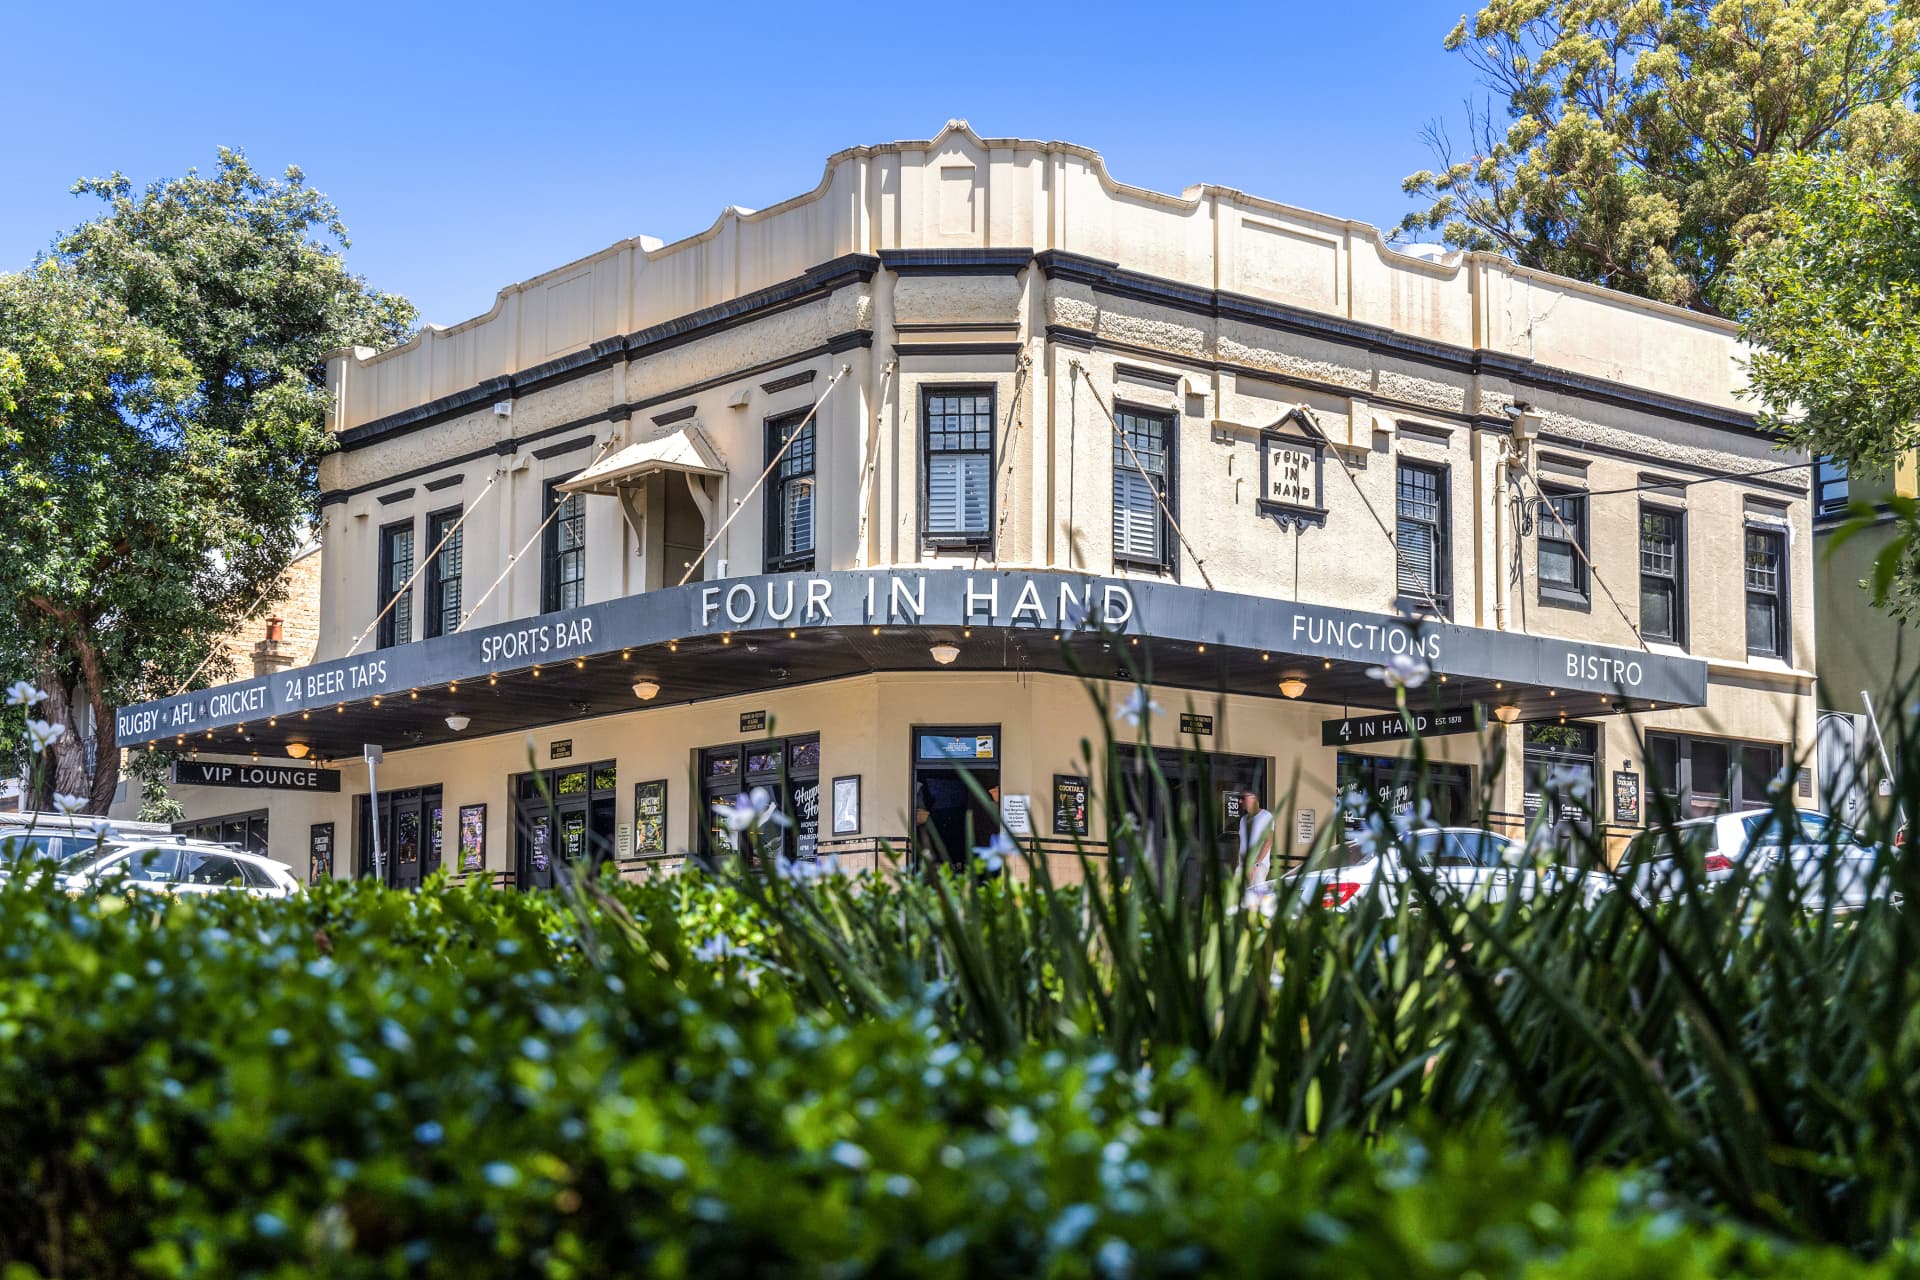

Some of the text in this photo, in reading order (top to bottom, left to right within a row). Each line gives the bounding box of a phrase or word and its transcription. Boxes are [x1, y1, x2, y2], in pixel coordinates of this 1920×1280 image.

[1273, 451, 1310, 471] FOUR
[1285, 467, 1298, 481] IN
[1273, 482, 1310, 500] HAND
[702, 576, 1134, 626] FOUR IN HAND
[482, 617, 593, 663] SPORTS BAR
[1292, 615, 1441, 659] FUNCTIONS
[285, 660, 387, 702] 24 BEER TAPS
[1566, 653, 1642, 686] BISTRO
[118, 686, 267, 737] RUGBY AFL CRICKET
[1339, 721, 1352, 742] 4
[1360, 721, 1375, 737] IN
[1382, 716, 1427, 735] HAND
[202, 766, 318, 786] VIP LOUNGE
[1228, 802, 1239, 810] $30
